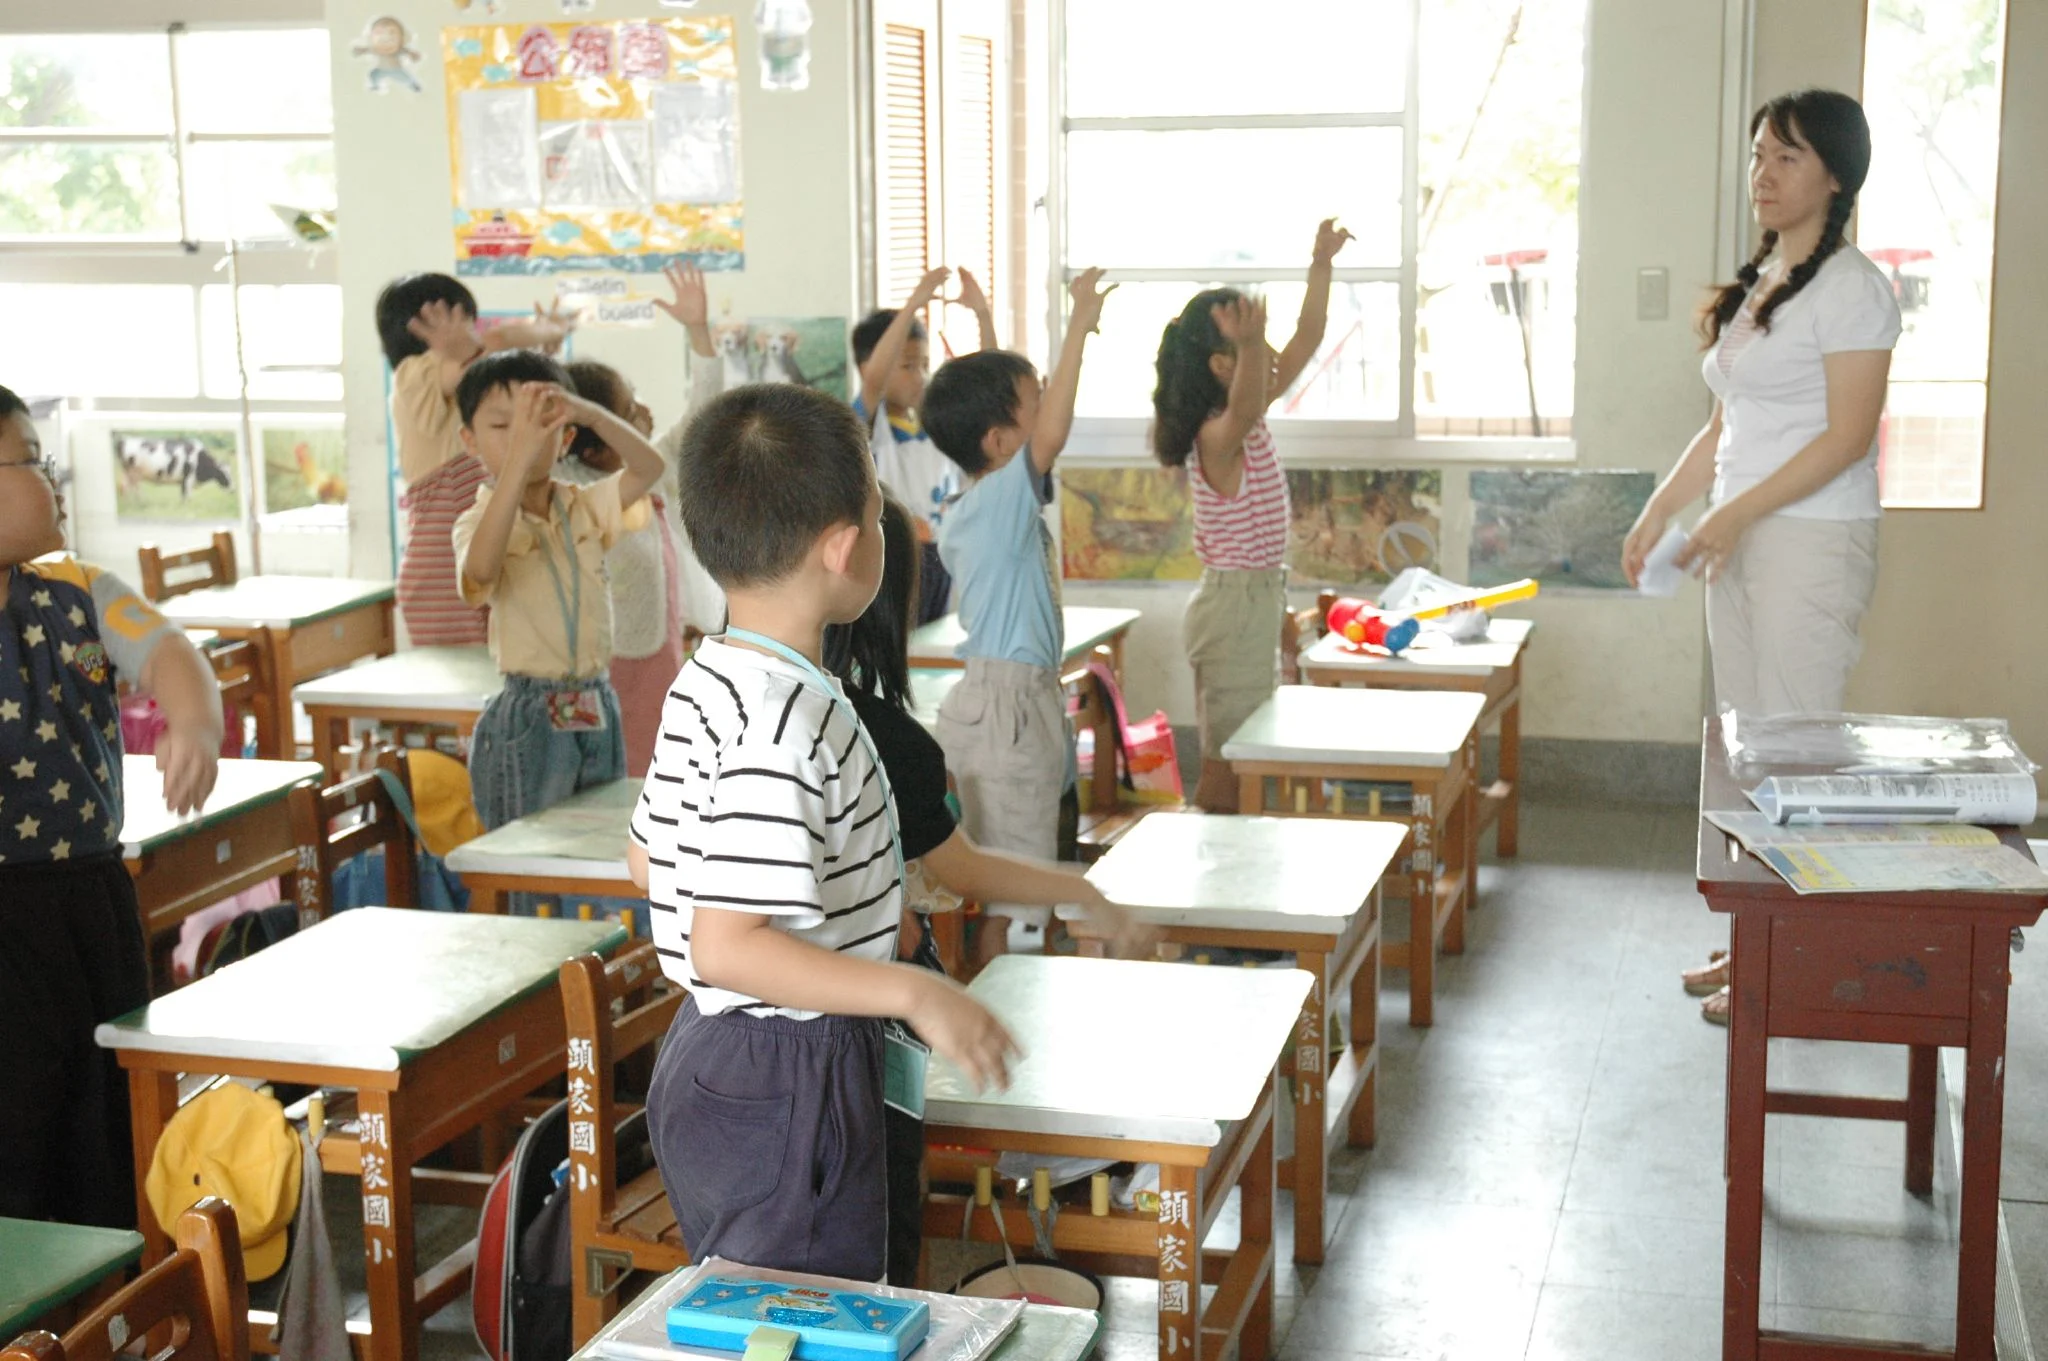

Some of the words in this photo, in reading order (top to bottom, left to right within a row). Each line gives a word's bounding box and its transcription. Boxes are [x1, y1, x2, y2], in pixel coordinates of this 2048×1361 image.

[567, 1037, 598, 1192] 頭家國小
[1295, 980, 1321, 1105] 家國小
[360, 1112, 393, 1264] 頭家國小
[1158, 1190, 1191, 1355] 頭家國小
